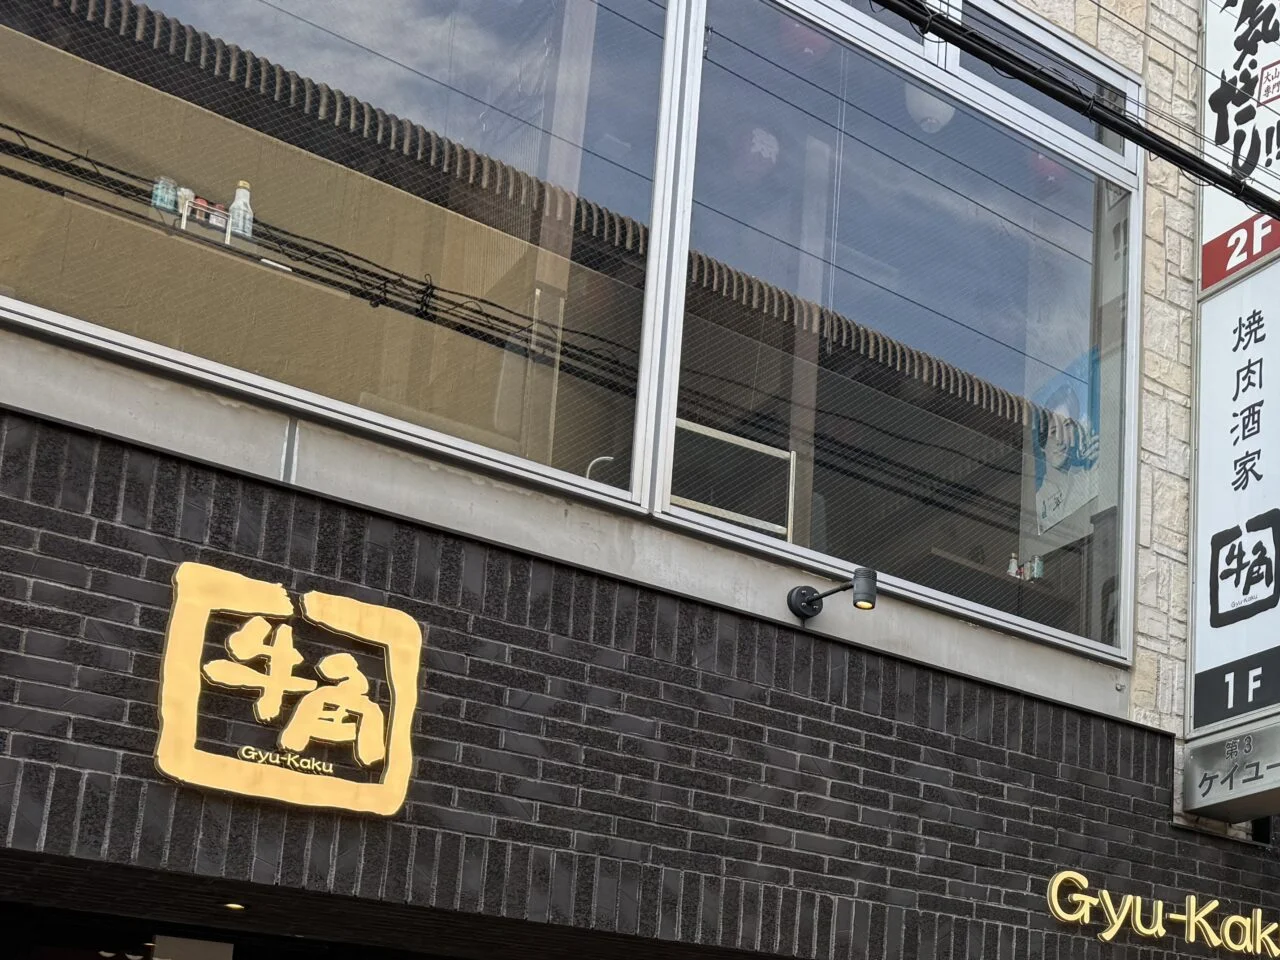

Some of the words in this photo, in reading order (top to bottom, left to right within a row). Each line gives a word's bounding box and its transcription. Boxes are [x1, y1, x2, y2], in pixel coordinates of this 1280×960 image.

[1226, 215, 1272, 271] 2F
[1231, 310, 1267, 493] 焼肉酒家
[1224, 666, 1262, 709] 1F
[237, 745, 334, 774] Gyu-Kaku
